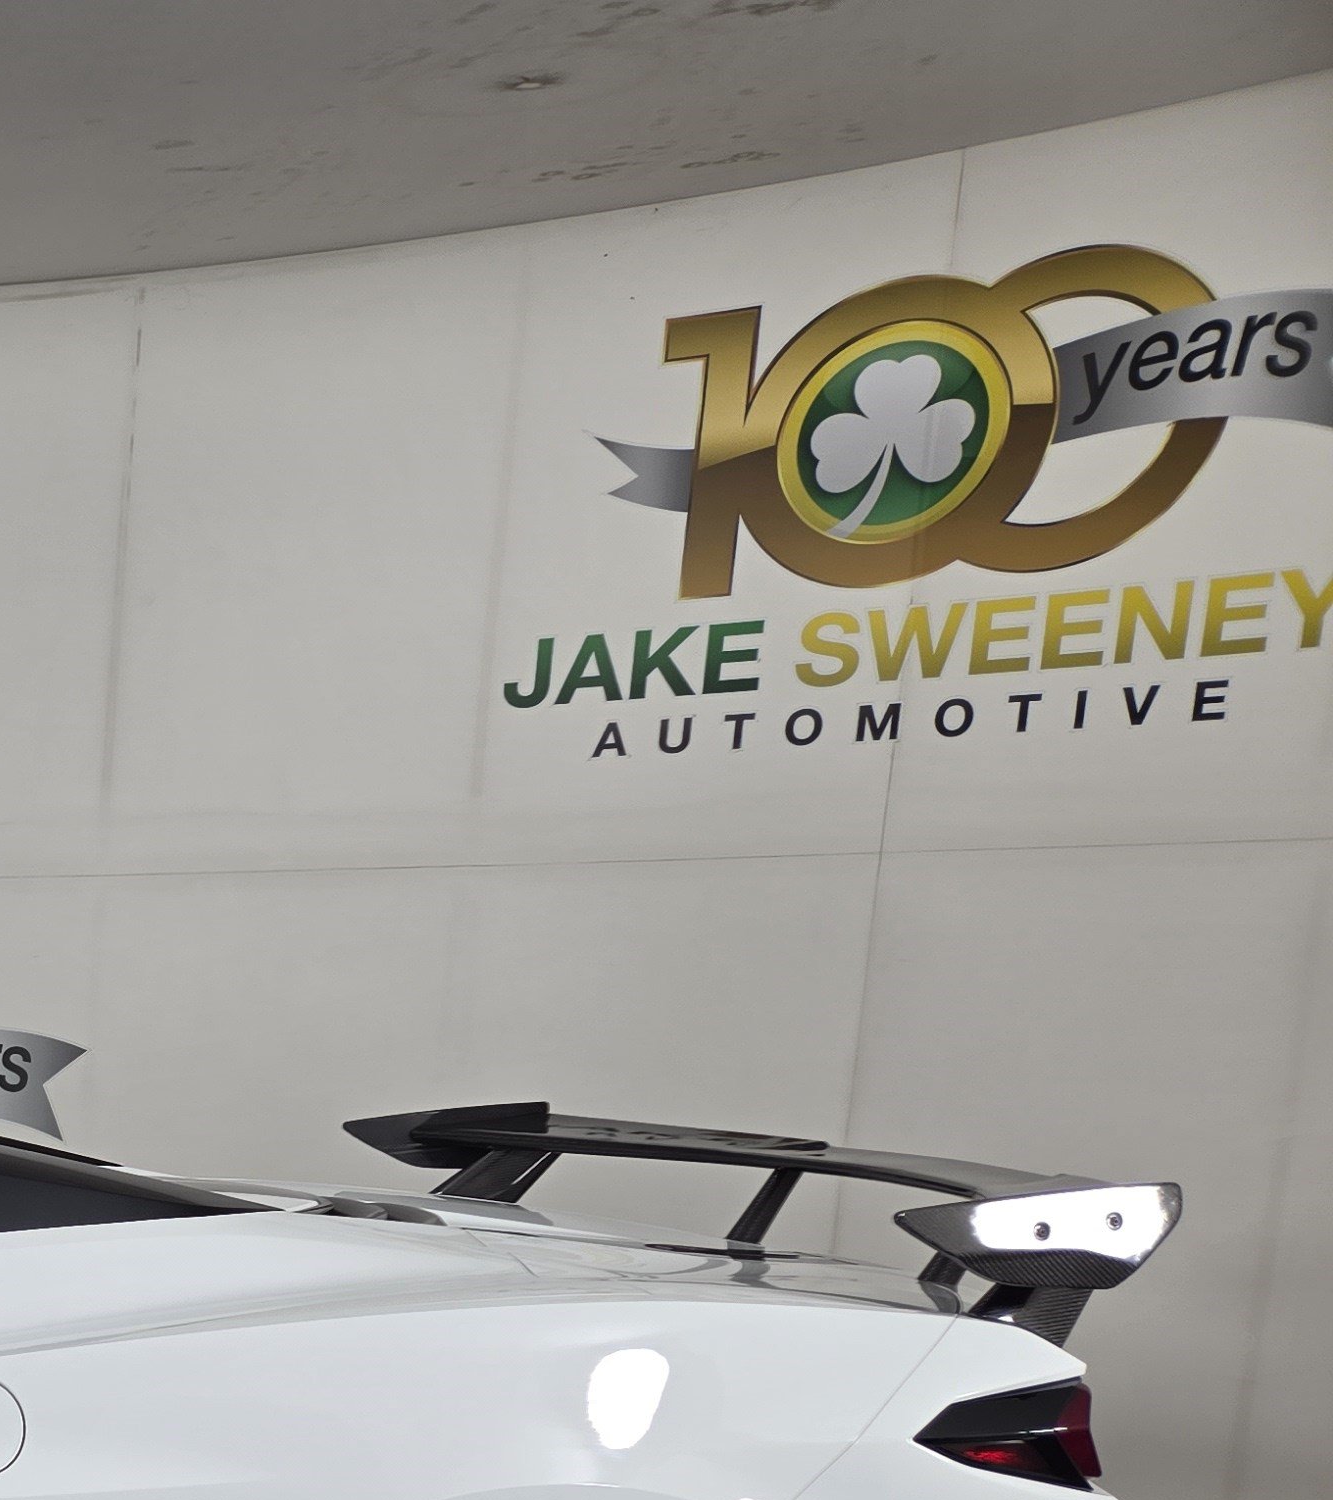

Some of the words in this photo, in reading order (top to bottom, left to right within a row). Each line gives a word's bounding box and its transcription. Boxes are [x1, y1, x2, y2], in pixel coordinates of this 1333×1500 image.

[663, 244, 1228, 599] 100
[1072, 309, 1319, 425] years
[503, 619, 765, 709] JAKE
[794, 569, 1333, 688] SWEENEY
[591, 680, 1231, 759] AUTOMOTIVE
